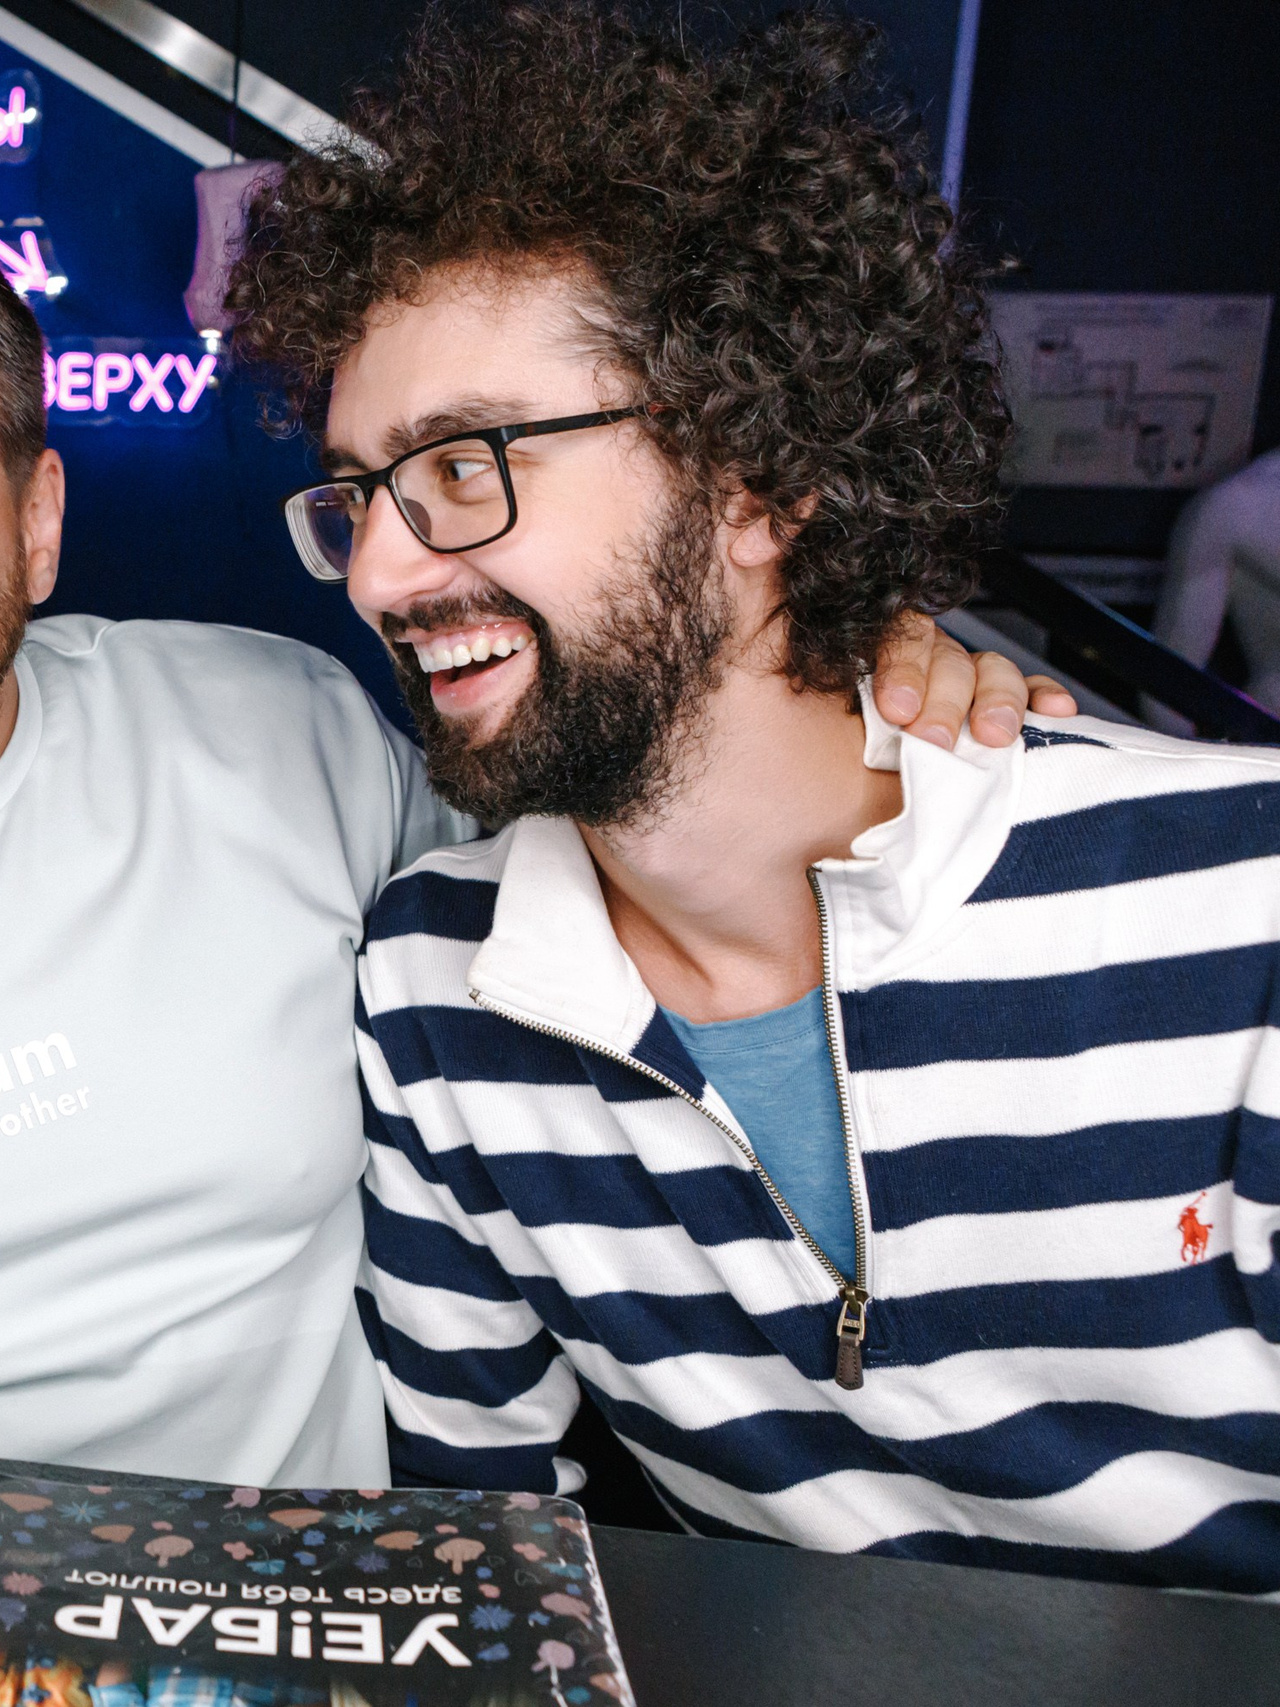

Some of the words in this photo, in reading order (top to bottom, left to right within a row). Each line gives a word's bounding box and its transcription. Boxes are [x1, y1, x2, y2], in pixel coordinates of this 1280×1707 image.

[64, 1568, 227, 1598] пошлют
[241, 1583, 333, 1605] тебя
[343, 1584, 463, 1605] здесь
[54, 1594, 472, 1667] УЕ!БАР
